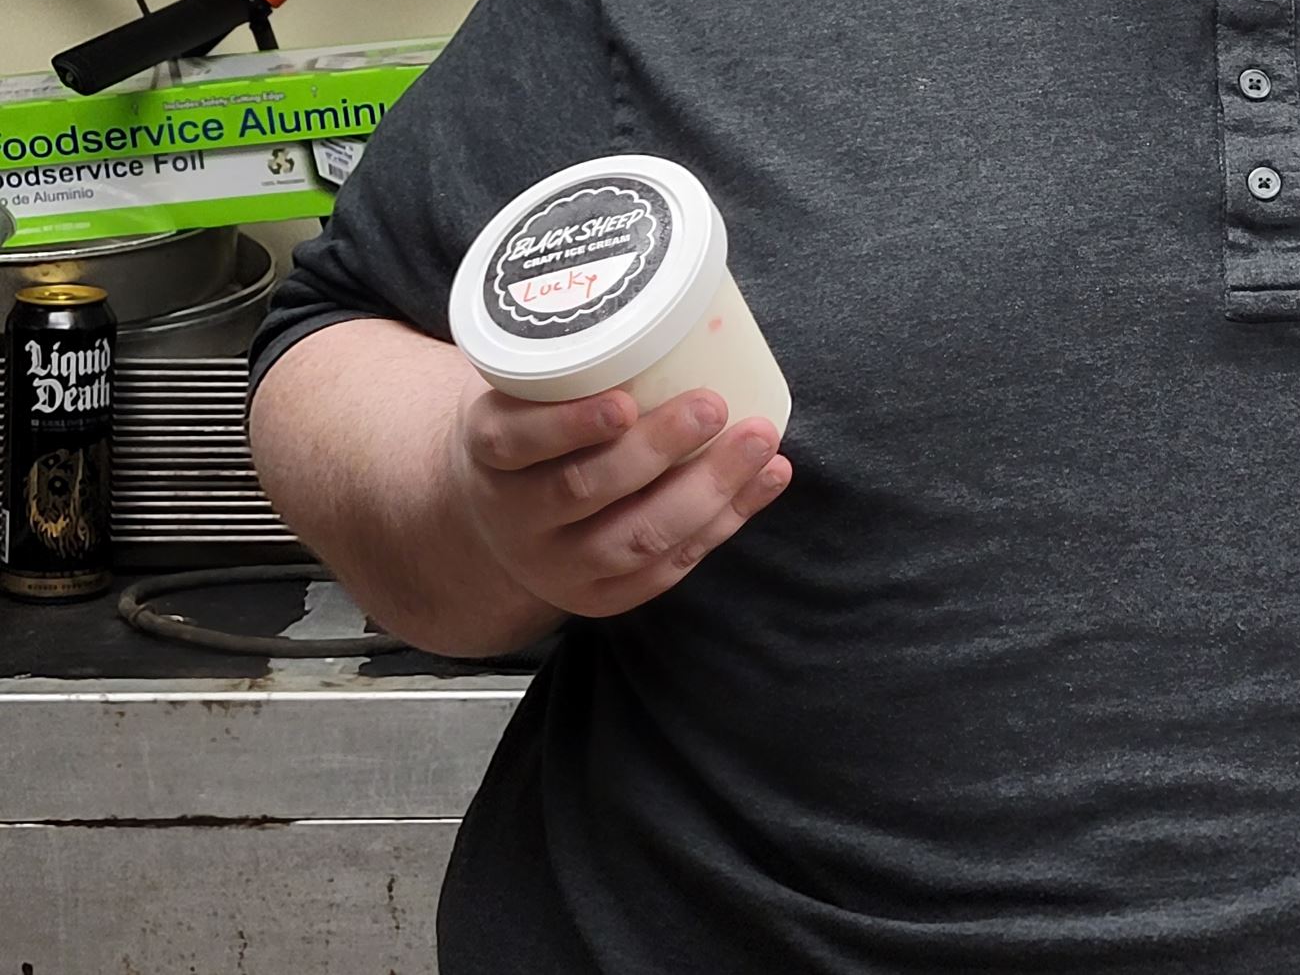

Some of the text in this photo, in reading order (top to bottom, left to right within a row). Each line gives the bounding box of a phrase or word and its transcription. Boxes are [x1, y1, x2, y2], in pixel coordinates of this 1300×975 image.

[0, 115, 224, 161] oodservice
[0, 150, 205, 189] odservice Foil
[12, 195, 30, 206] de
[33, 187, 94, 204] Aluminio
[508, 209, 645, 261] BLACK SHEEP
[523, 234, 631, 269] CRAFT ICE CREAM
[25, 337, 110, 386] Liquid
[31, 373, 110, 414] Death
